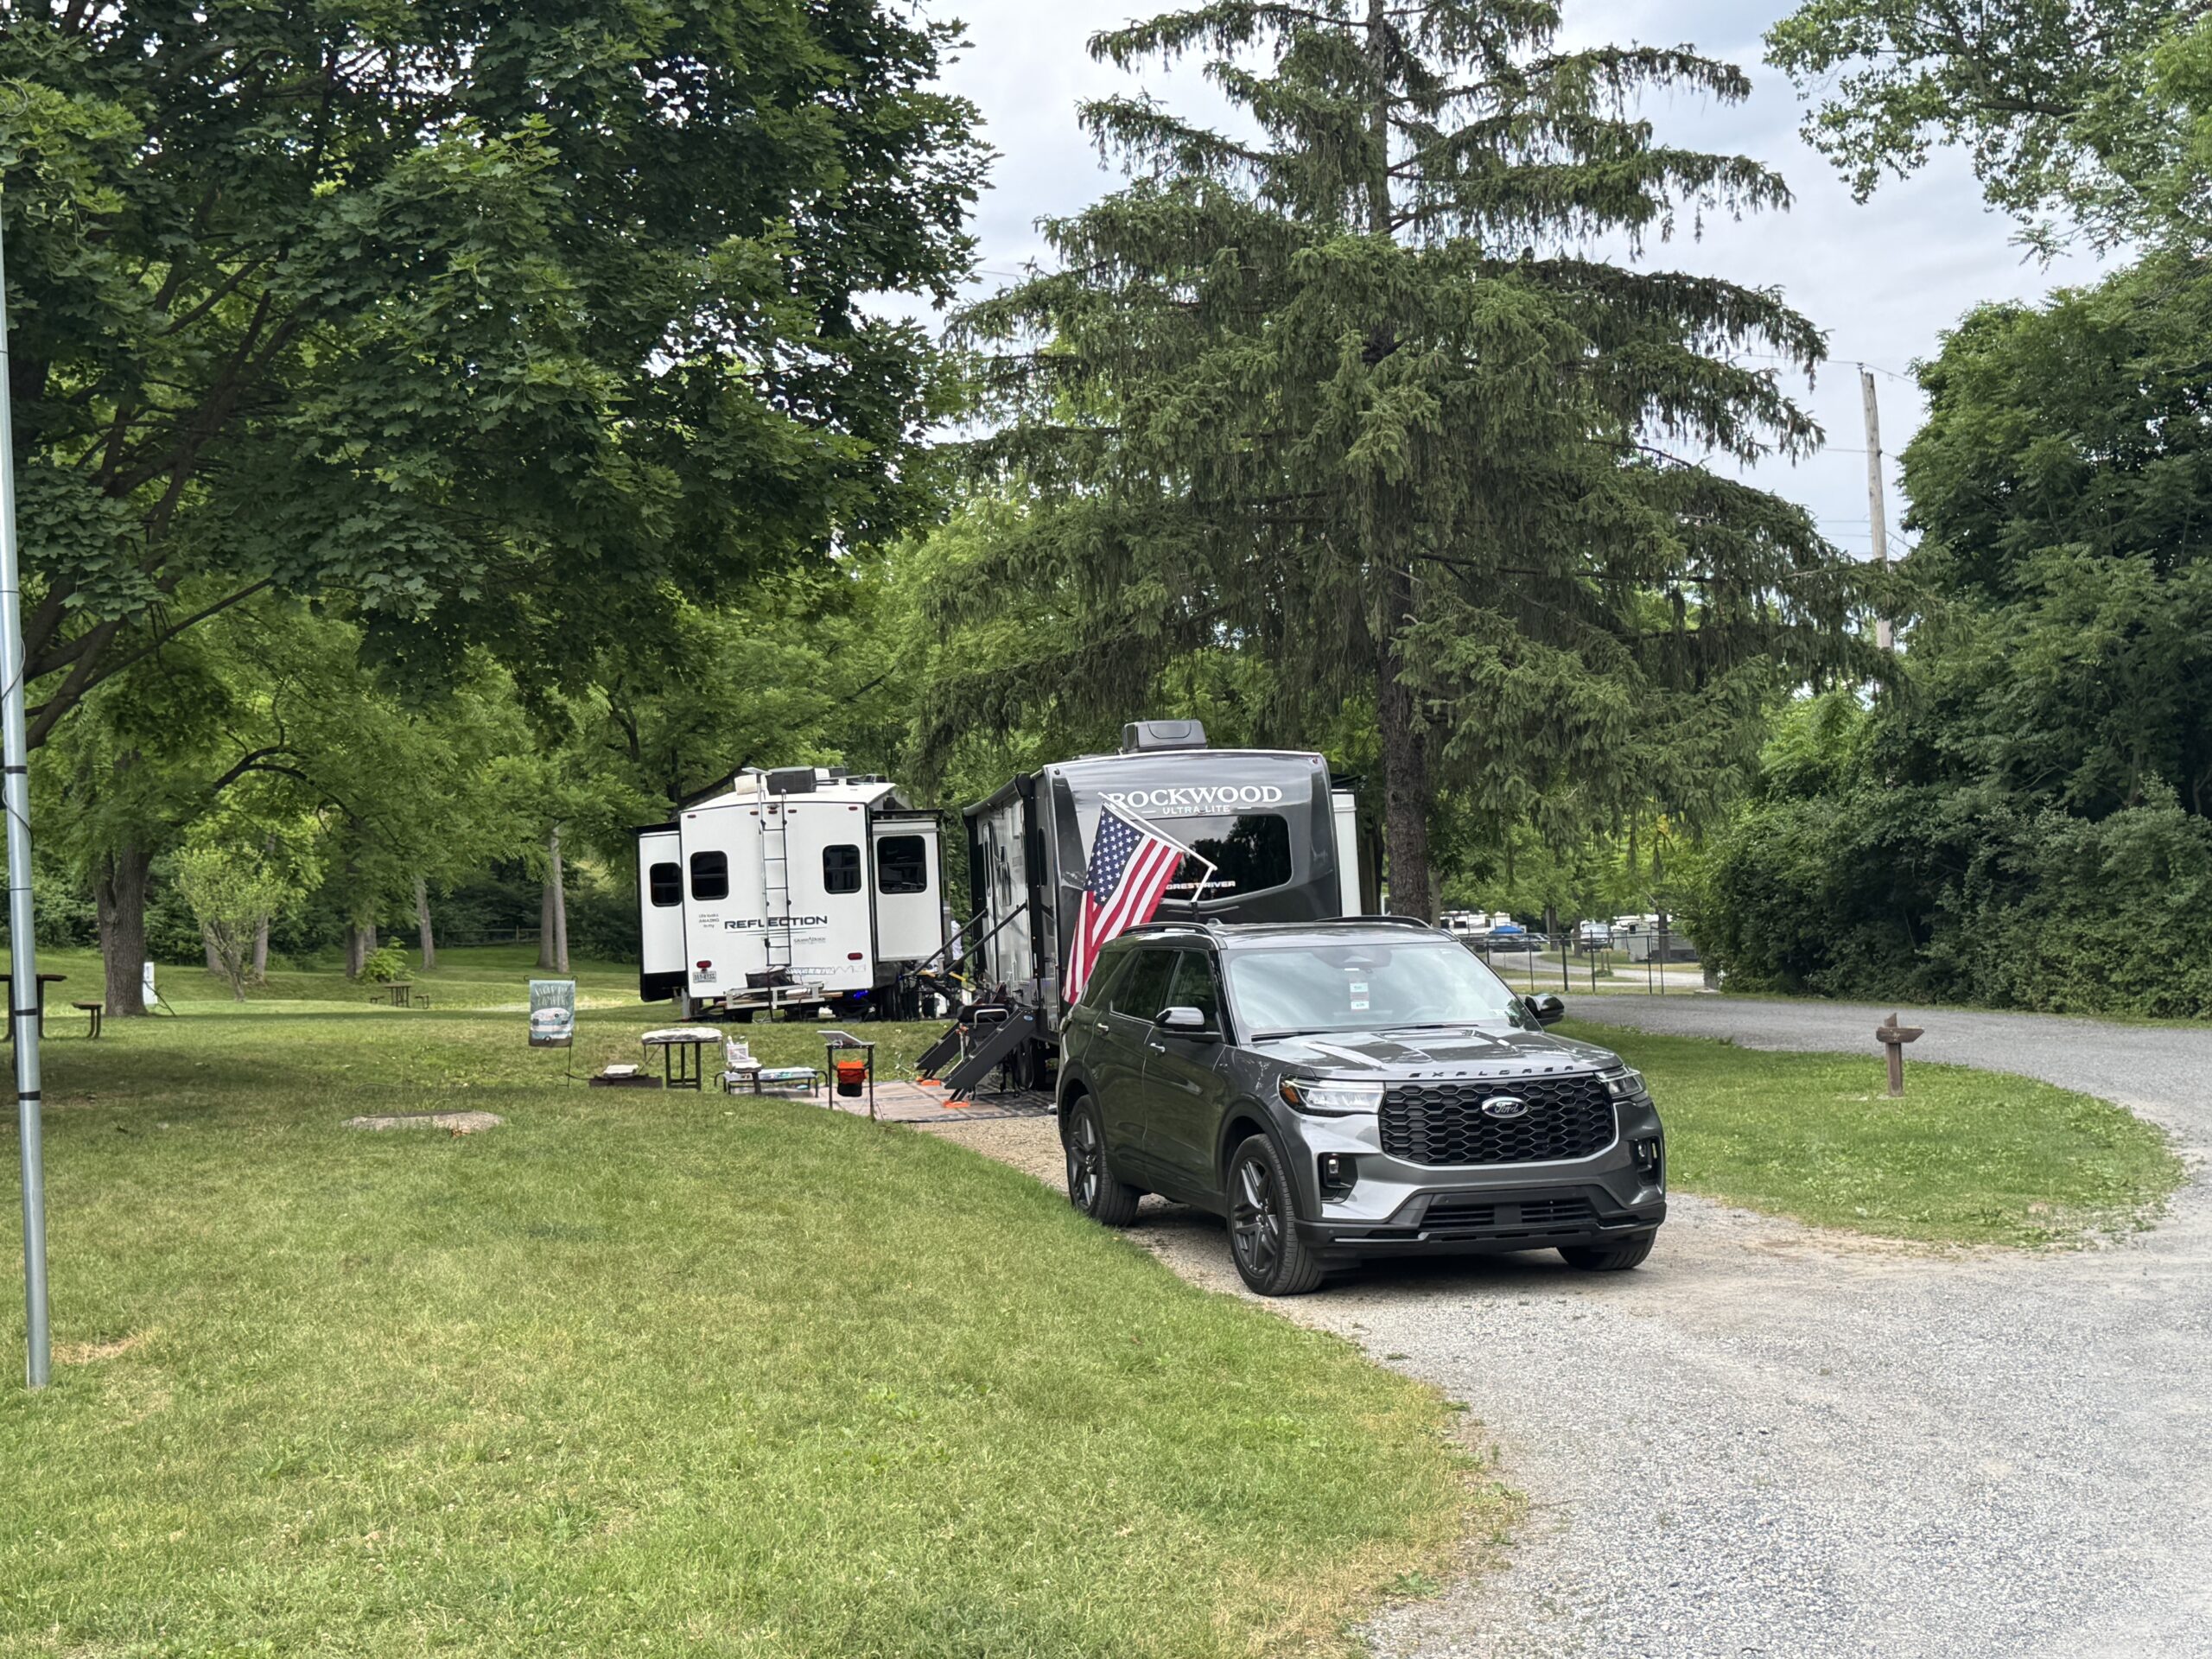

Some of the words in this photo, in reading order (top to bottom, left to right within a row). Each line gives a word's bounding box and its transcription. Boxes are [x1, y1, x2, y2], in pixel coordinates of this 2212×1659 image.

[1108, 786, 1283, 810] ROCKWOOD
[1163, 806, 1200, 815] ULTRA
[1205, 804, 1231, 813] LITE
[724, 916, 828, 930] REFLECTION
[1408, 1065, 1574, 1078] EXPLORER
[1494, 1102, 1519, 1114] Ford
